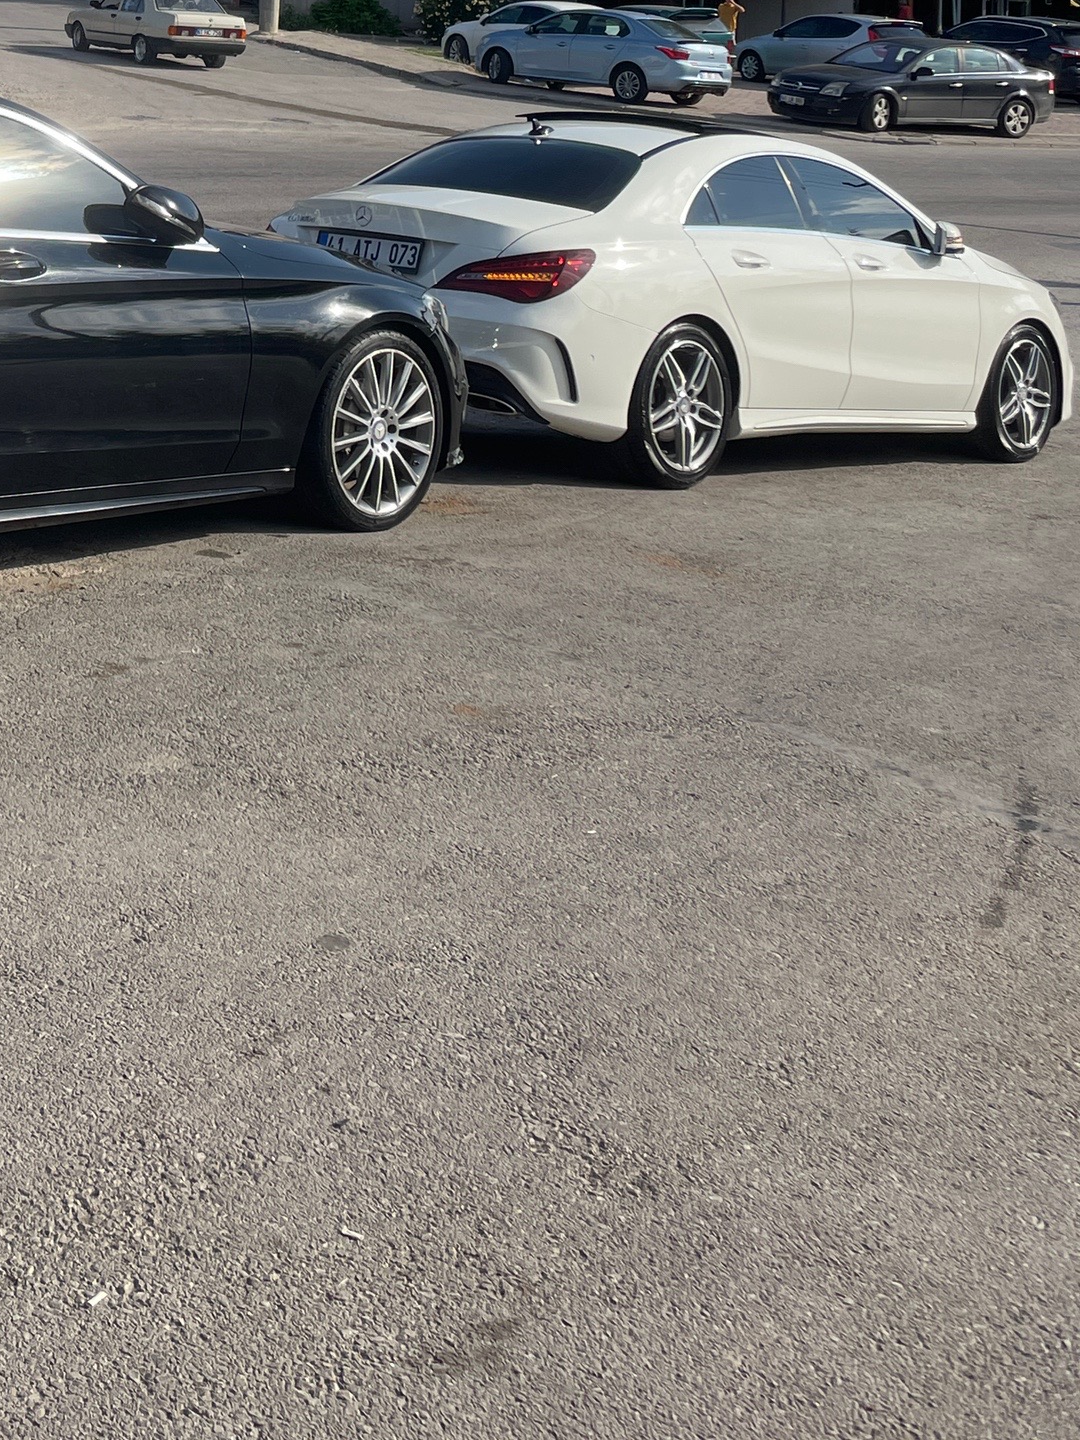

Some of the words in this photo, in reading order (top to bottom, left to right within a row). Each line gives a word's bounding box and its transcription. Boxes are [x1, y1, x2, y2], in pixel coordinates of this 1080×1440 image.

[326, 235, 344, 253] 41
[352, 238, 382, 261] ATJ
[388, 243, 418, 266] 073
